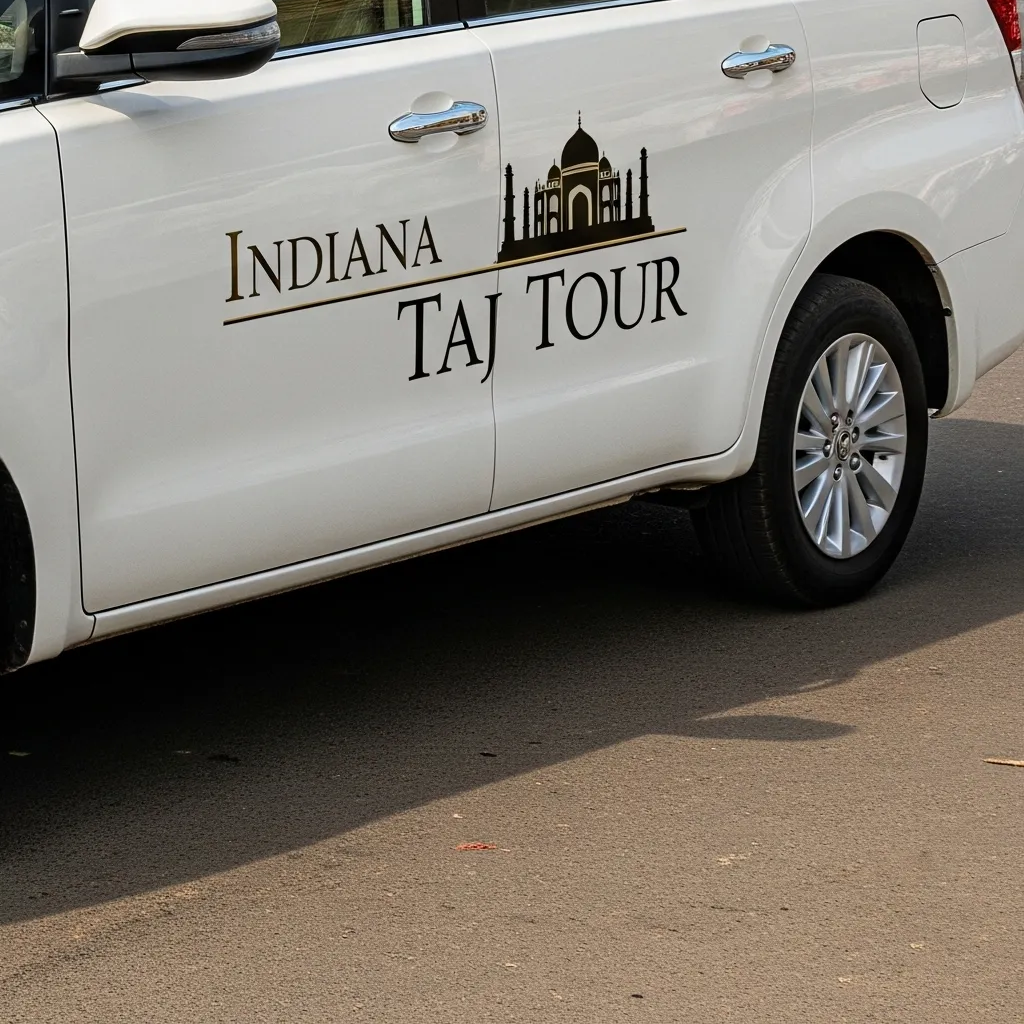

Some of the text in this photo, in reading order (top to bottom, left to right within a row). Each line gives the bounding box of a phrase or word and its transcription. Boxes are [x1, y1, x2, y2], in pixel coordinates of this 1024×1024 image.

[225, 215, 443, 304] INDIANA
[397, 255, 688, 384] TAJ TOUR
